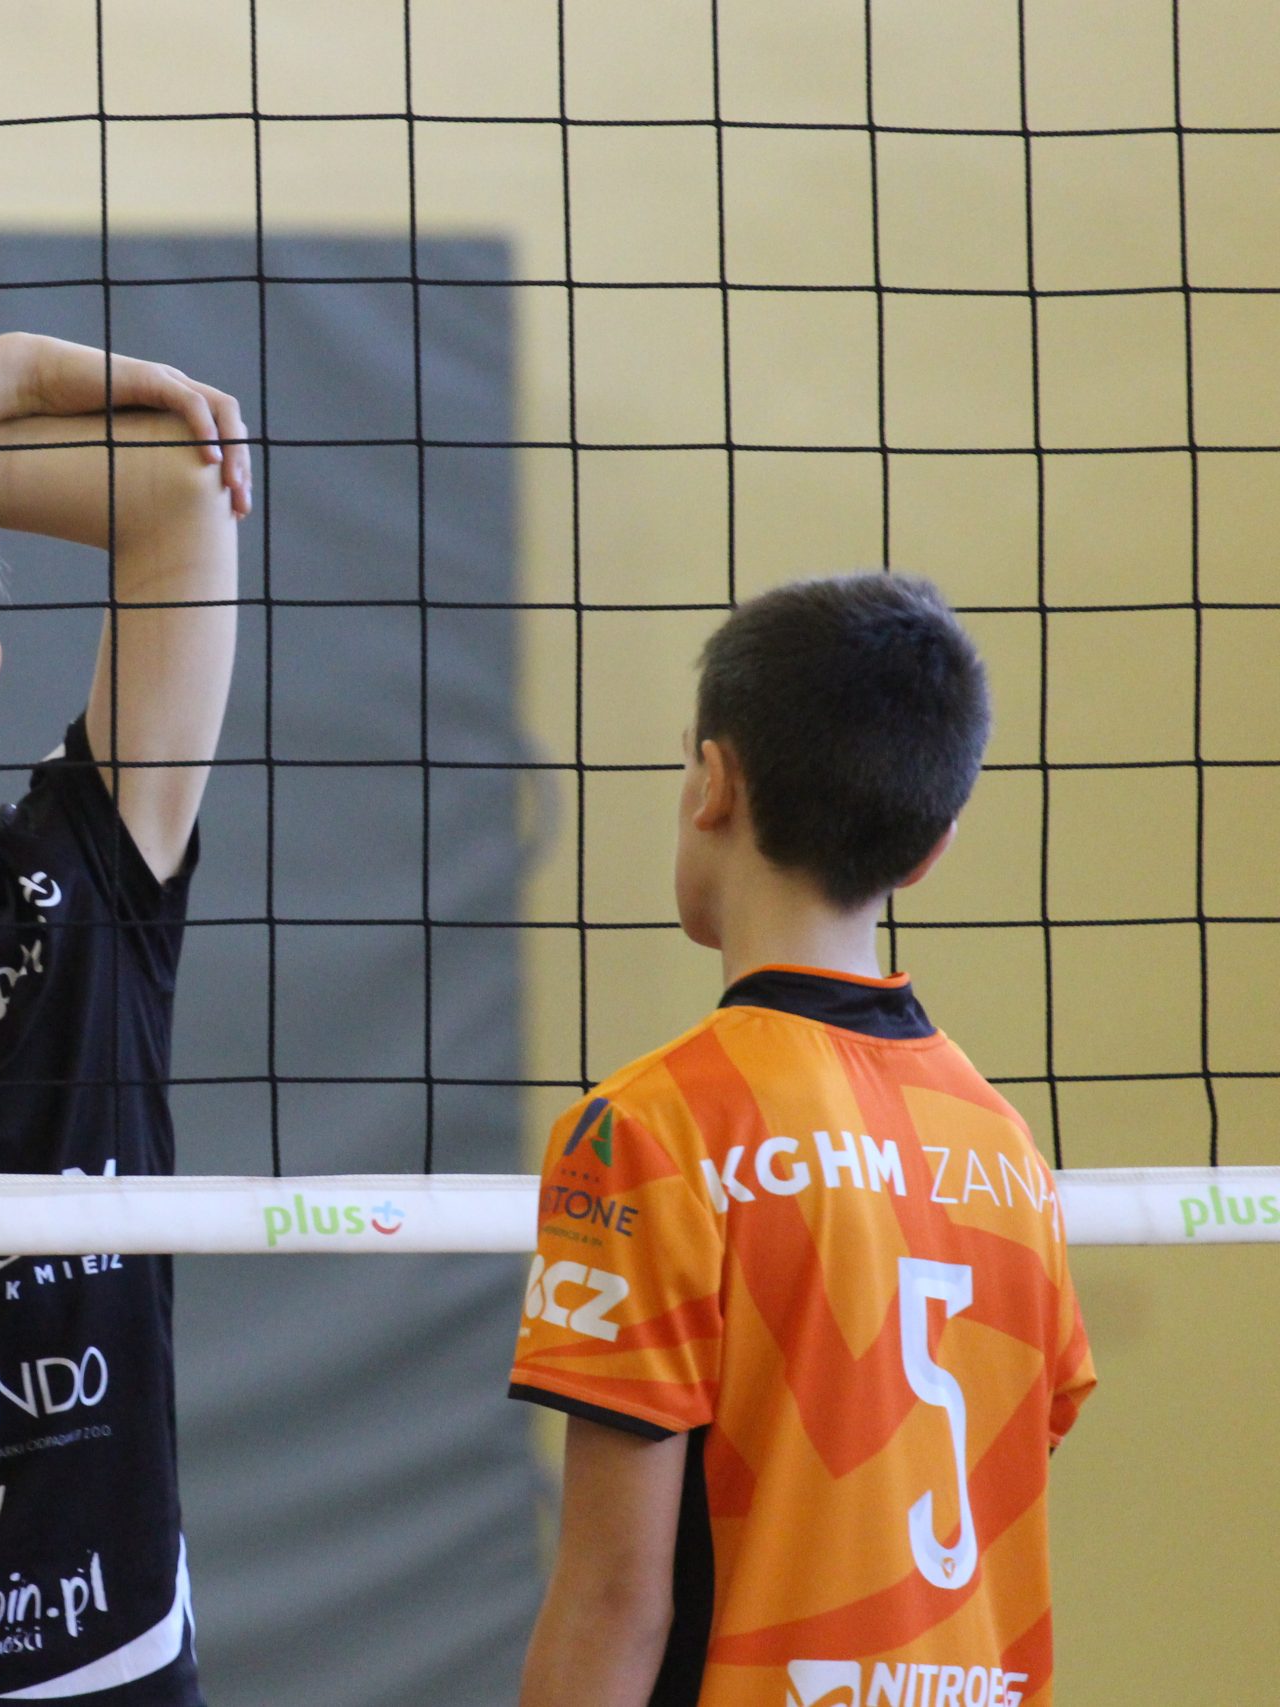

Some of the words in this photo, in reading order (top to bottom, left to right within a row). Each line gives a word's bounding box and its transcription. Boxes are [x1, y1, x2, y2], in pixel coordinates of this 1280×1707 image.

[263, 1193, 366, 1248] plus
[699, 1130, 908, 1214] KGHM
[922, 1145, 1061, 1244] ZANA
[1179, 1184, 1280, 1238] plus
[897, 1256, 978, 1590] 5
